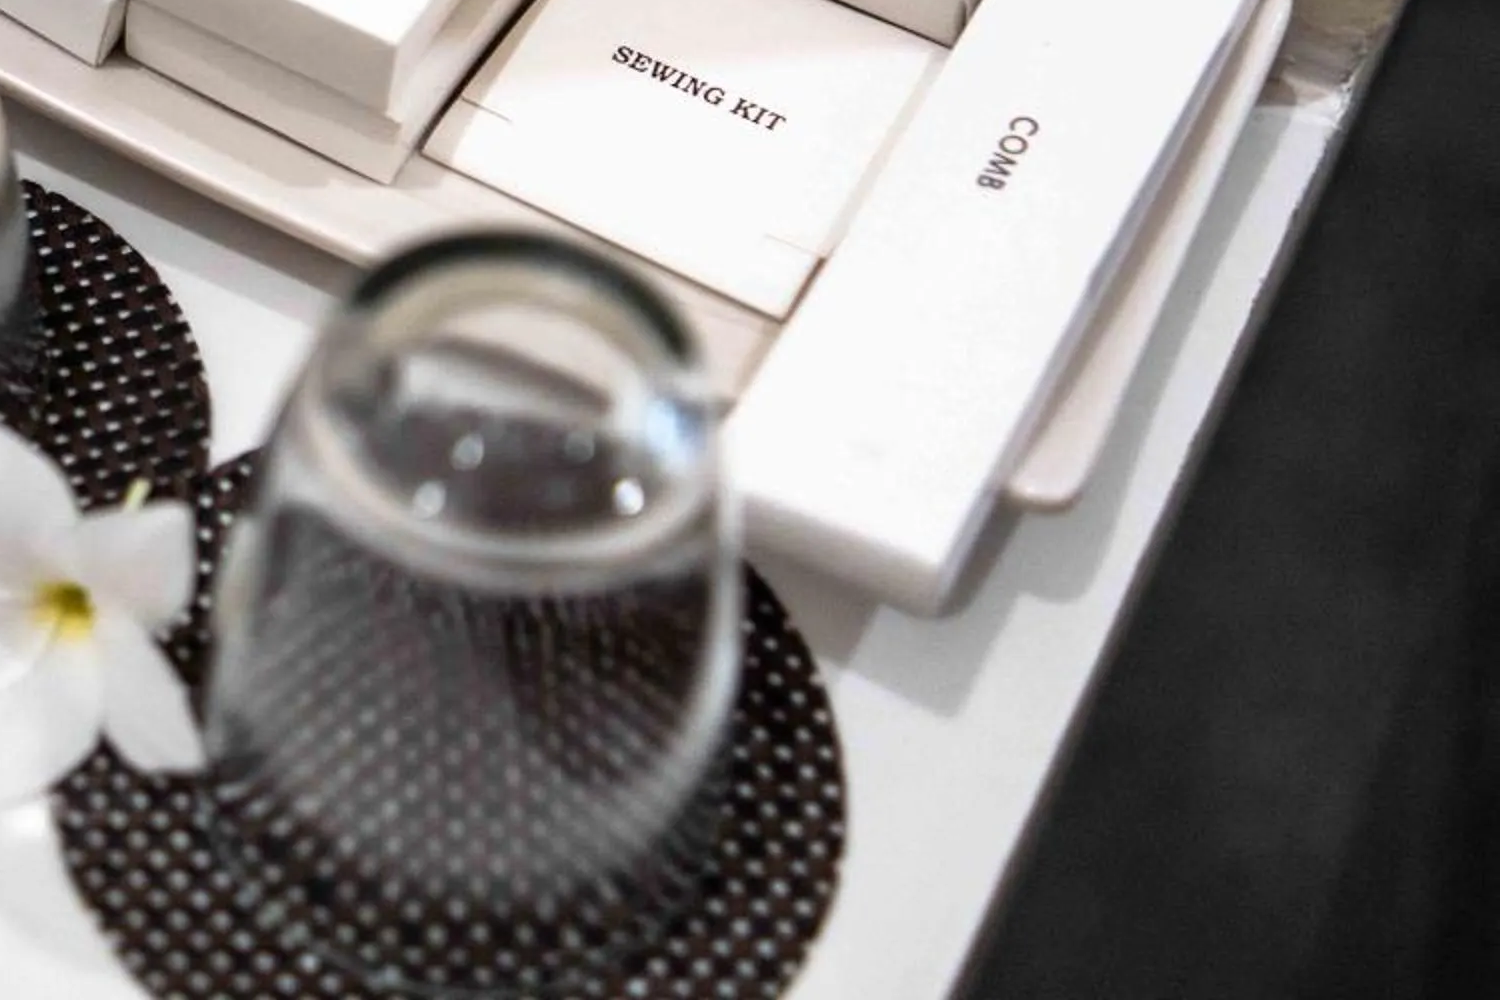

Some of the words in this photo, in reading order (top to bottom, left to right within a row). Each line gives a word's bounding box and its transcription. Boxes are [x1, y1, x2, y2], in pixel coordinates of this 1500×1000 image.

[611, 45, 726, 107] SEWING
[730, 97, 788, 132] KIT
[976, 116, 1039, 191] COMB
